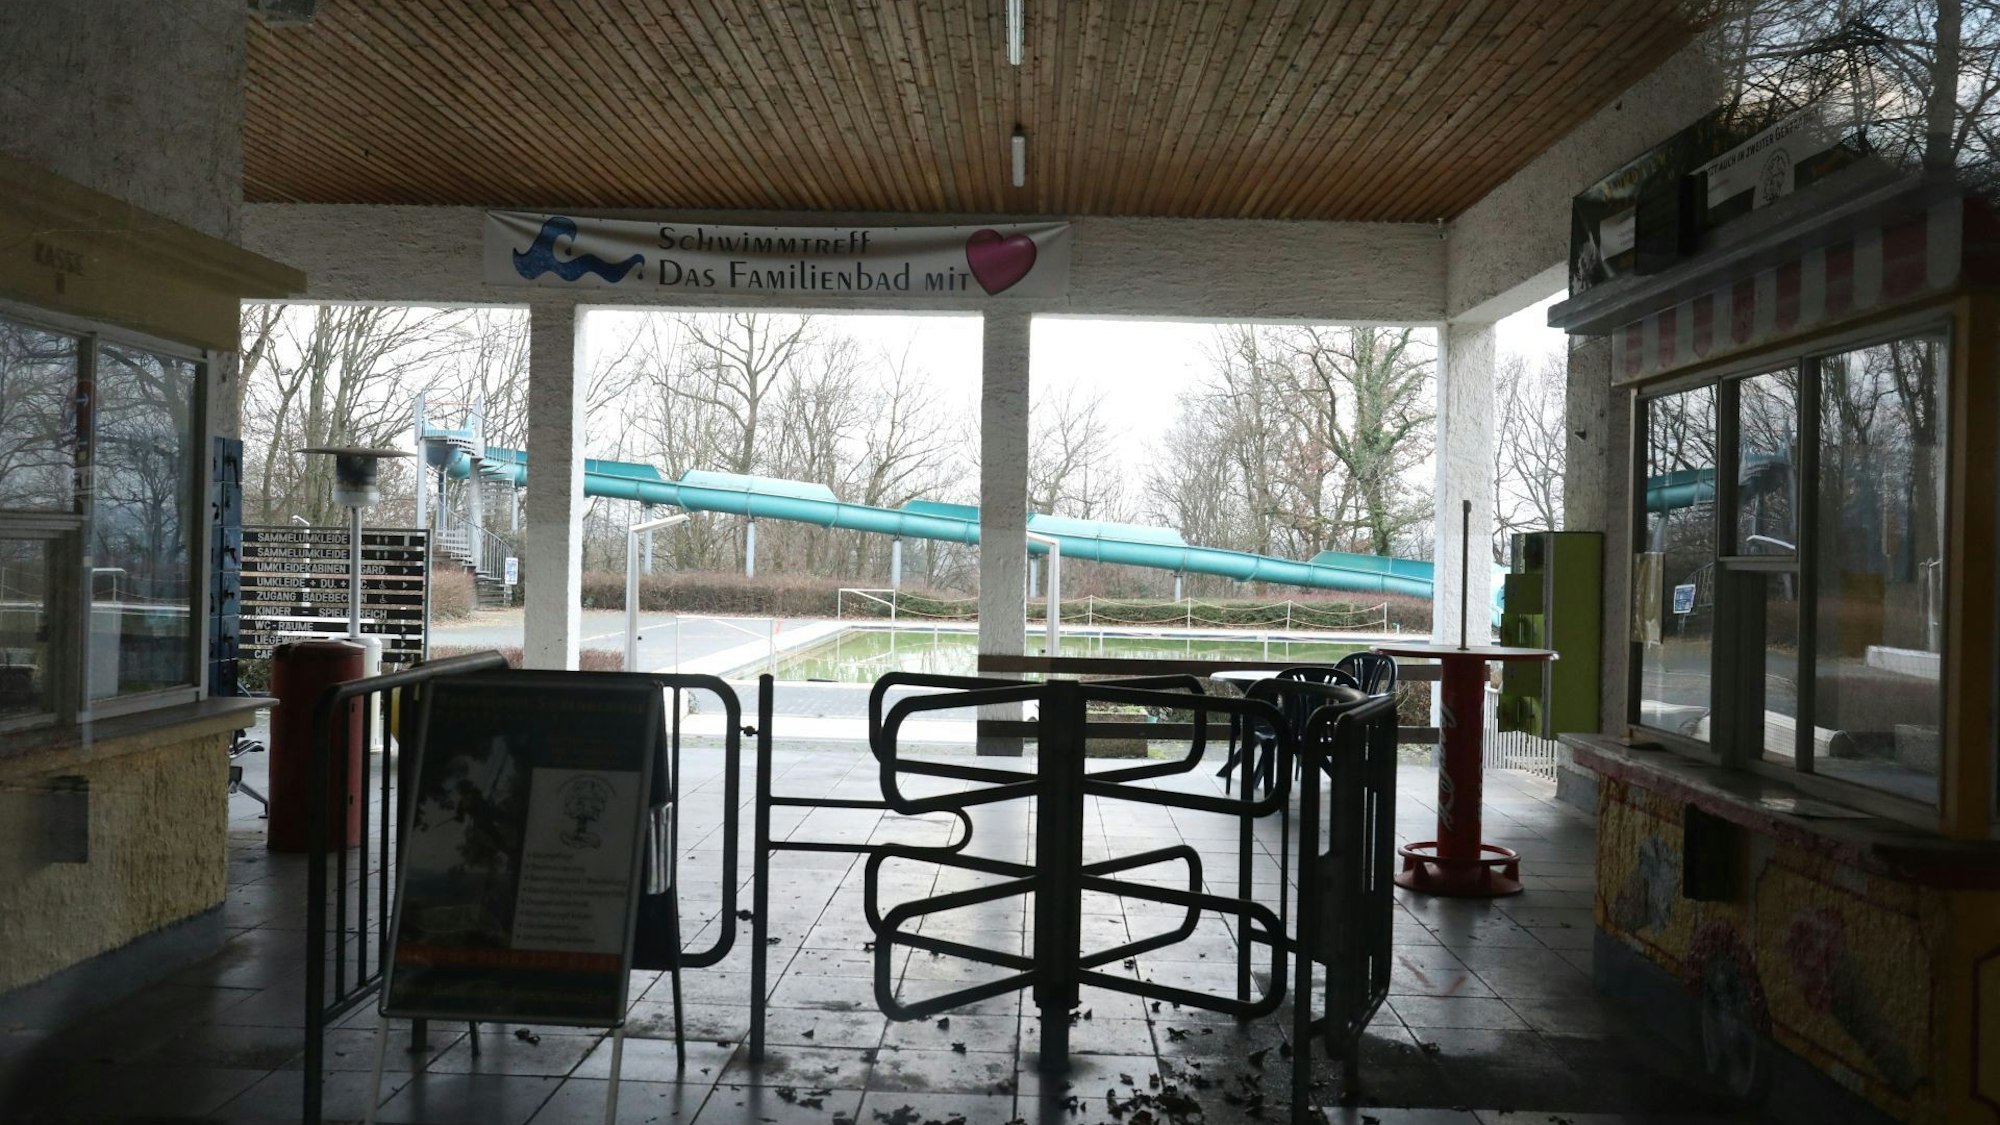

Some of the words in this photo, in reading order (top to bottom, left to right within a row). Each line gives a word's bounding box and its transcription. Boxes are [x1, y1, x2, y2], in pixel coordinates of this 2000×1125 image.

[1718, 154, 1736, 172] AUCH
[1745, 134, 1774, 158] ZWEITER
[659, 259, 715, 287] Das
[730, 261, 909, 291] Familienbad
[257, 533, 348, 544] SAMMELUMKLEIDE
[257, 547, 348, 559] SAMMELUMKLEIDE
[256, 562, 347, 574] UMKLEIDEKABINEN
[256, 577, 306, 588] UMKLEIDE
[320, 579, 337, 588] DU.
[256, 591, 296, 602] ZUGANG
[302, 593, 368, 604] BADEBECN
[255, 606, 292, 616] KINDER
[319, 608, 387, 619] SPIELBREICH
[254, 650, 273, 659] CAF
